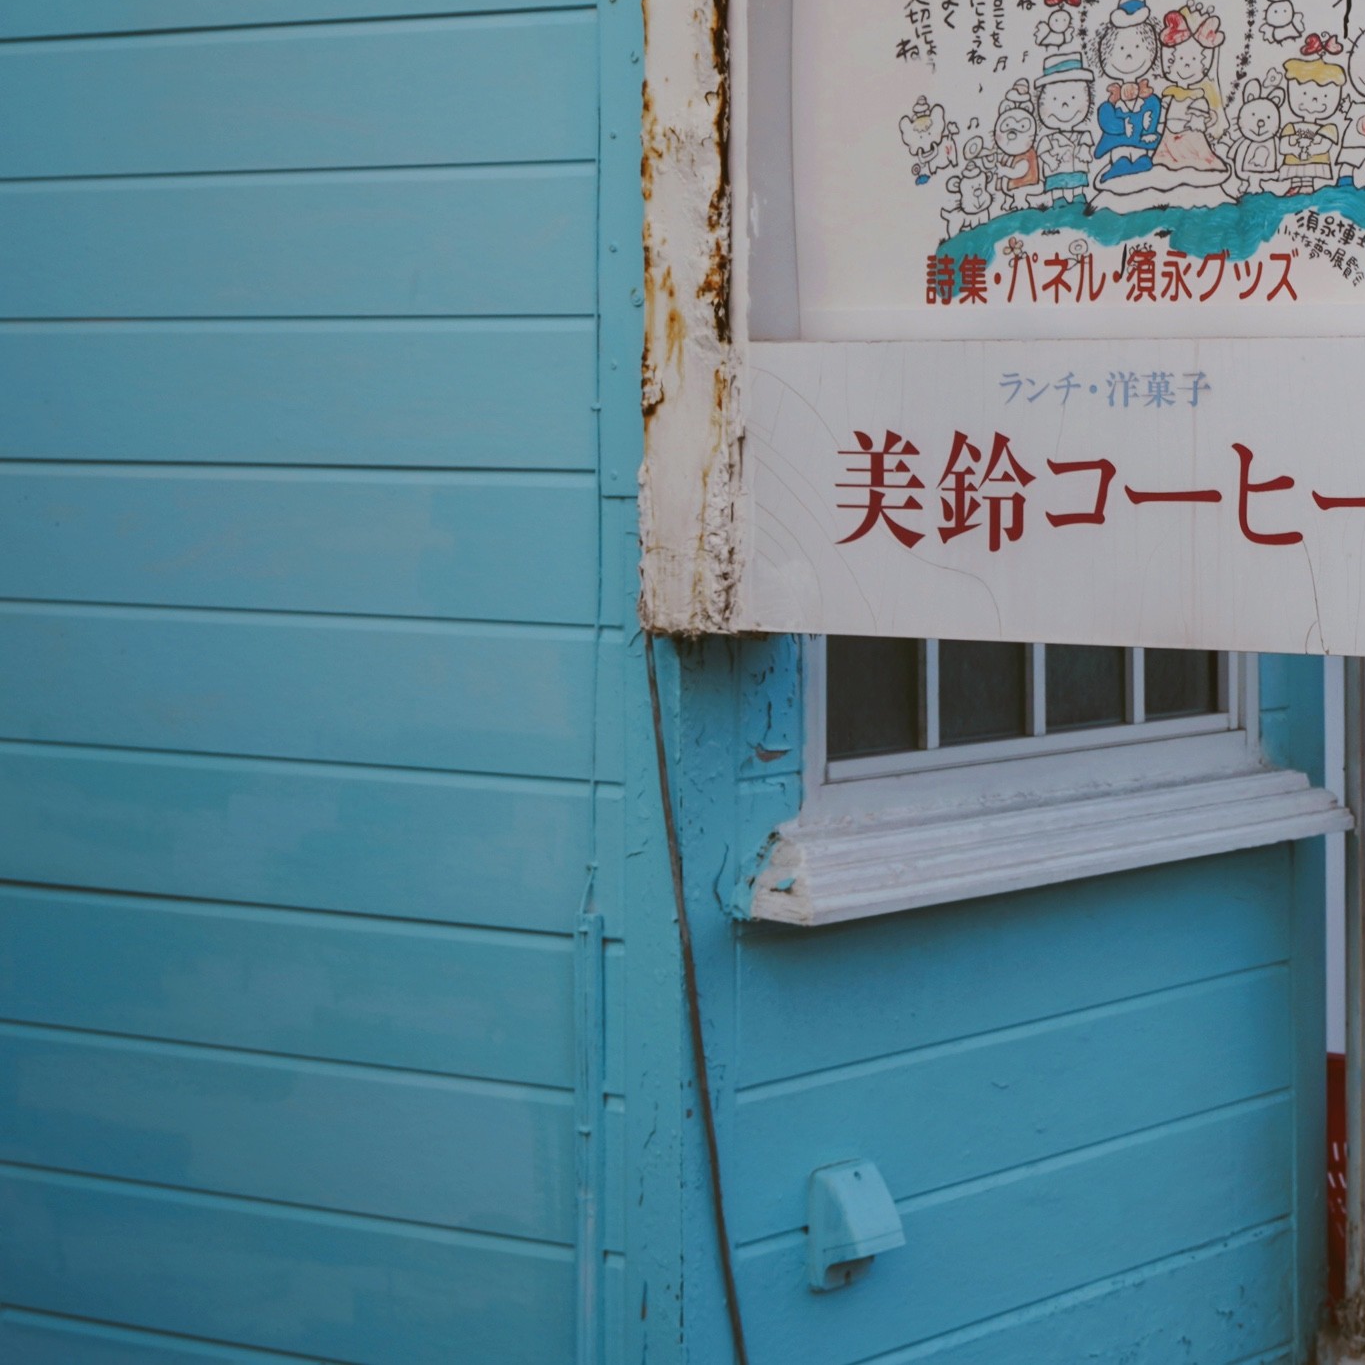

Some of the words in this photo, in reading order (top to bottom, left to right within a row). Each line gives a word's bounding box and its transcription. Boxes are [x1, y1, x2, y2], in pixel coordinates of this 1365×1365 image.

[998, 370, 1212, 409] ランチ・洋菓子
